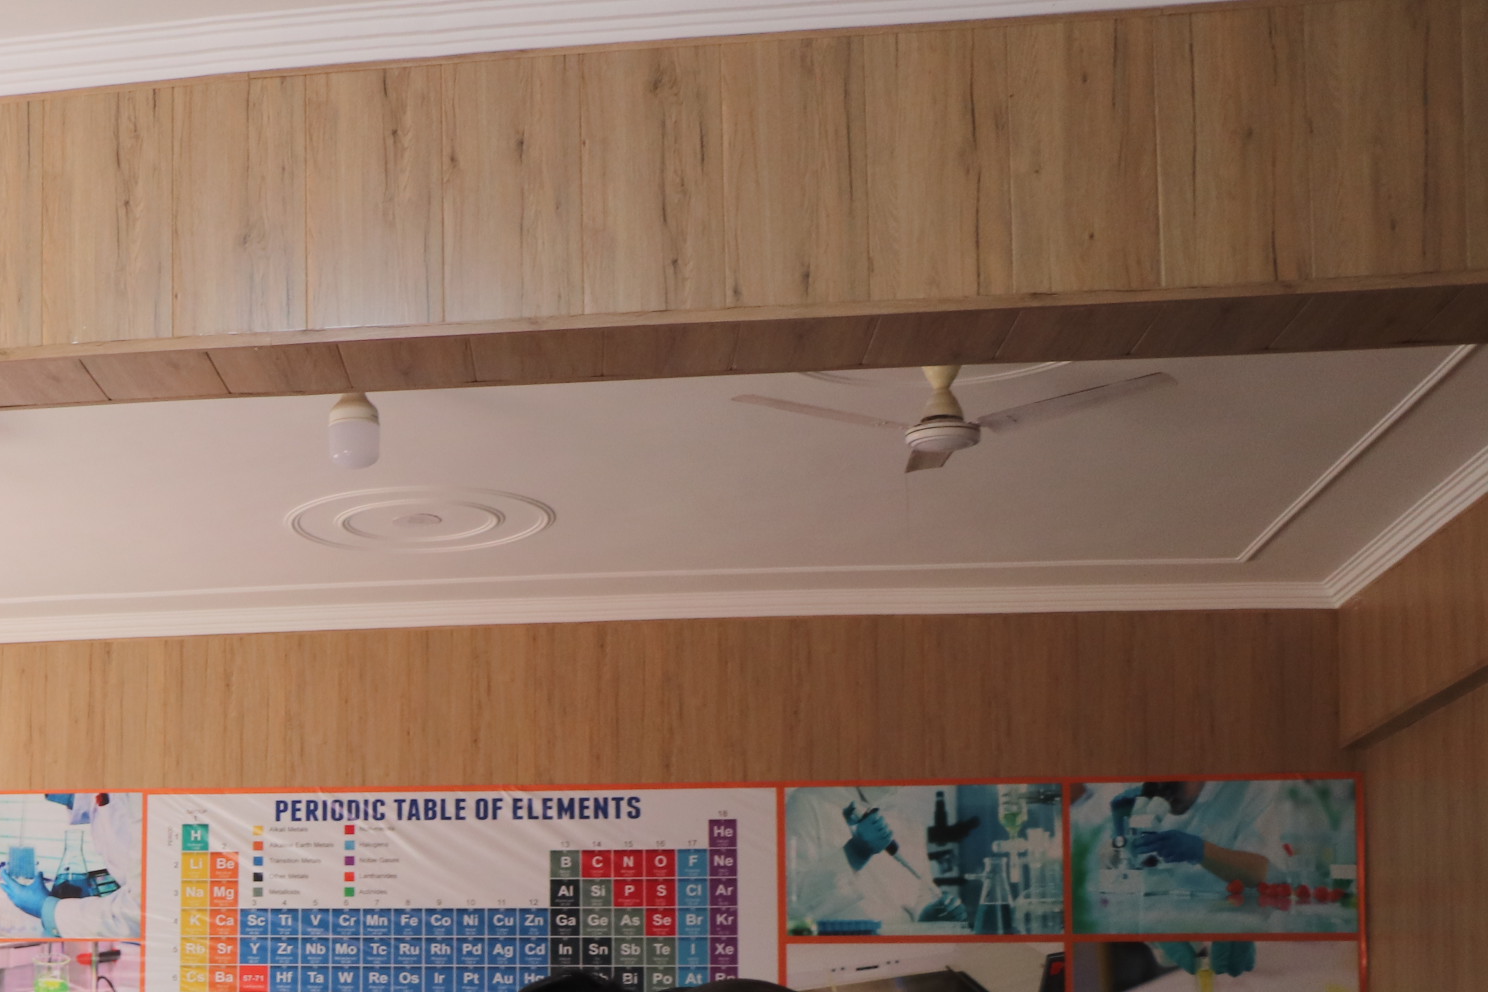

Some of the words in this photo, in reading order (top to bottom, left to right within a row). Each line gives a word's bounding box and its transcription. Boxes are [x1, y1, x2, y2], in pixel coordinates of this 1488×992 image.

[275, 800, 385, 822] PERIODIC
[394, 799, 466, 821] TABLE
[476, 798, 504, 820] OF
[513, 797, 641, 819] ELEMENTS
[191, 830, 201, 840] H
[714, 826, 733, 837] He
[190, 859, 202, 869] Li
[216, 859, 234, 869] Be
[562, 856, 571, 867] B
[592, 856, 603, 867] C
[624, 856, 633, 867] N
[655, 856, 667, 867] O
[689, 855, 698, 866] F
[714, 855, 733, 866] Ne
[186, 887, 203, 897] Na
[214, 887, 234, 900] Mg
[558, 886, 573, 896] Al
[591, 885, 605, 896] Si
[625, 885, 634, 896] P
[657, 885, 666, 896] S
[686, 885, 701, 896] Cl
[716, 885, 733, 896] Ar
[190, 915, 200, 925] K
[216, 915, 234, 926] Ca
[247, 915, 265, 926] Sc
[279, 915, 292, 925] Ti
[310, 915, 321, 925] V
[339, 915, 356, 926] Cr
[367, 915, 388, 926] Mn
[401, 915, 418, 926] Fe
[431, 915, 451, 926] Co
[464, 915, 478, 925] Ni
[493, 915, 514, 926] Cu
[525, 915, 543, 926] Zn
[556, 915, 576, 926] Ga
[588, 915, 608, 926] Ge
[621, 915, 640, 926] As
[653, 914, 671, 926] Se
[686, 914, 703, 926] Br
[717, 914, 733, 926] Kr
[186, 943, 205, 954] Rb
[218, 943, 232, 953] Sr
[250, 943, 259, 953] Y
[278, 943, 293, 954] Zr
[306, 943, 326, 954] Nb
[336, 943, 357, 954] Mo
[370, 944, 387, 955] Tc
[400, 944, 419, 955] Ru
[431, 943, 450, 955] Rh
[463, 943, 481, 955] Pd
[493, 943, 514, 958] Ag
[525, 943, 545, 955] Cd
[559, 945, 572, 955] In
[589, 944, 608, 955] Sn
[621, 944, 640, 955] Sb
[654, 944, 670, 955] Te
[691, 944, 695, 954] I
[716, 944, 734, 955] Xe
[186, 972, 205, 982] Cs
[215, 972, 233, 982] Ba
[276, 972, 293, 982] Hf
[307, 972, 324, 983] Ta
[338, 972, 353, 983] W
[370, 973, 388, 984] Re
[399, 973, 419, 984] Os
[435, 973, 445, 984] Ir
[464, 973, 479, 984] Pt
[493, 973, 513, 984] Au
[623, 973, 637, 984] Bi
[653, 973, 672, 984] Po
[686, 973, 702, 984] At
